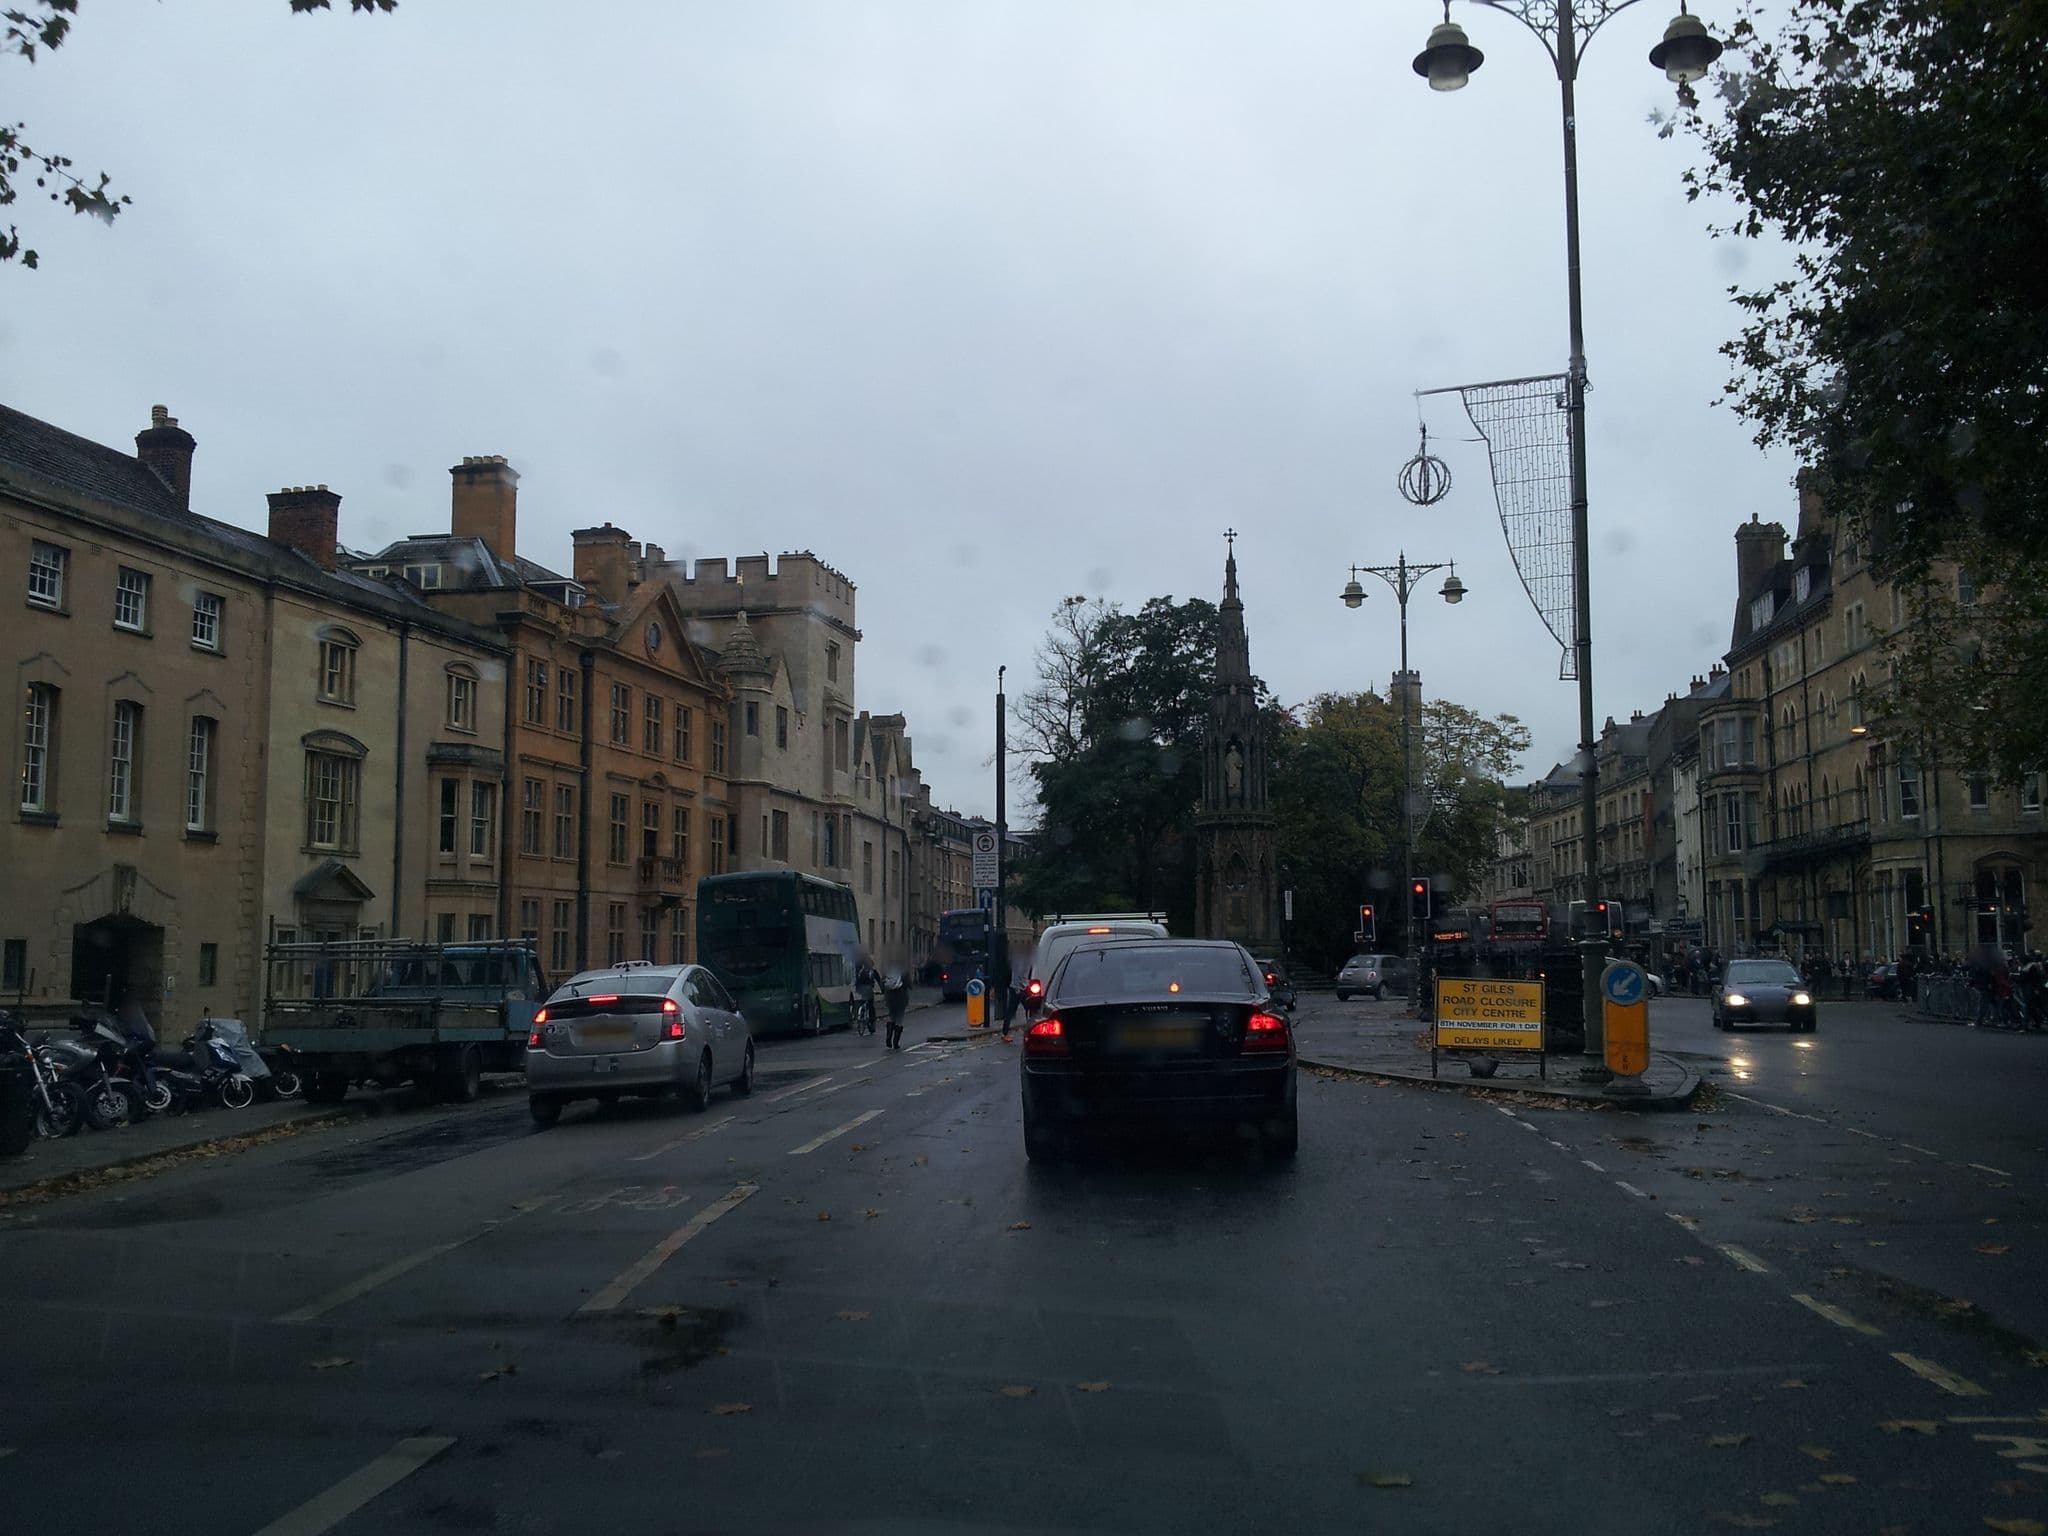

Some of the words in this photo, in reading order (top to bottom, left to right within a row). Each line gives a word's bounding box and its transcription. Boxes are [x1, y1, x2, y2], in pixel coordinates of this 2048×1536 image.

[1463, 984, 1476, 993] ST
[1482, 984, 1514, 994] GILES
[1443, 995, 1475, 1005] ROAD
[1480, 997, 1537, 1008] CLOSURE
[1453, 1007, 1478, 1017] CITY
[1482, 1008, 1526, 1018] CENTRE
[1457, 1021, 1498, 1029] NOVEMBER
[1454, 1036, 1489, 1045] DELAYS
[1493, 1037, 1523, 1046] LIKELY
